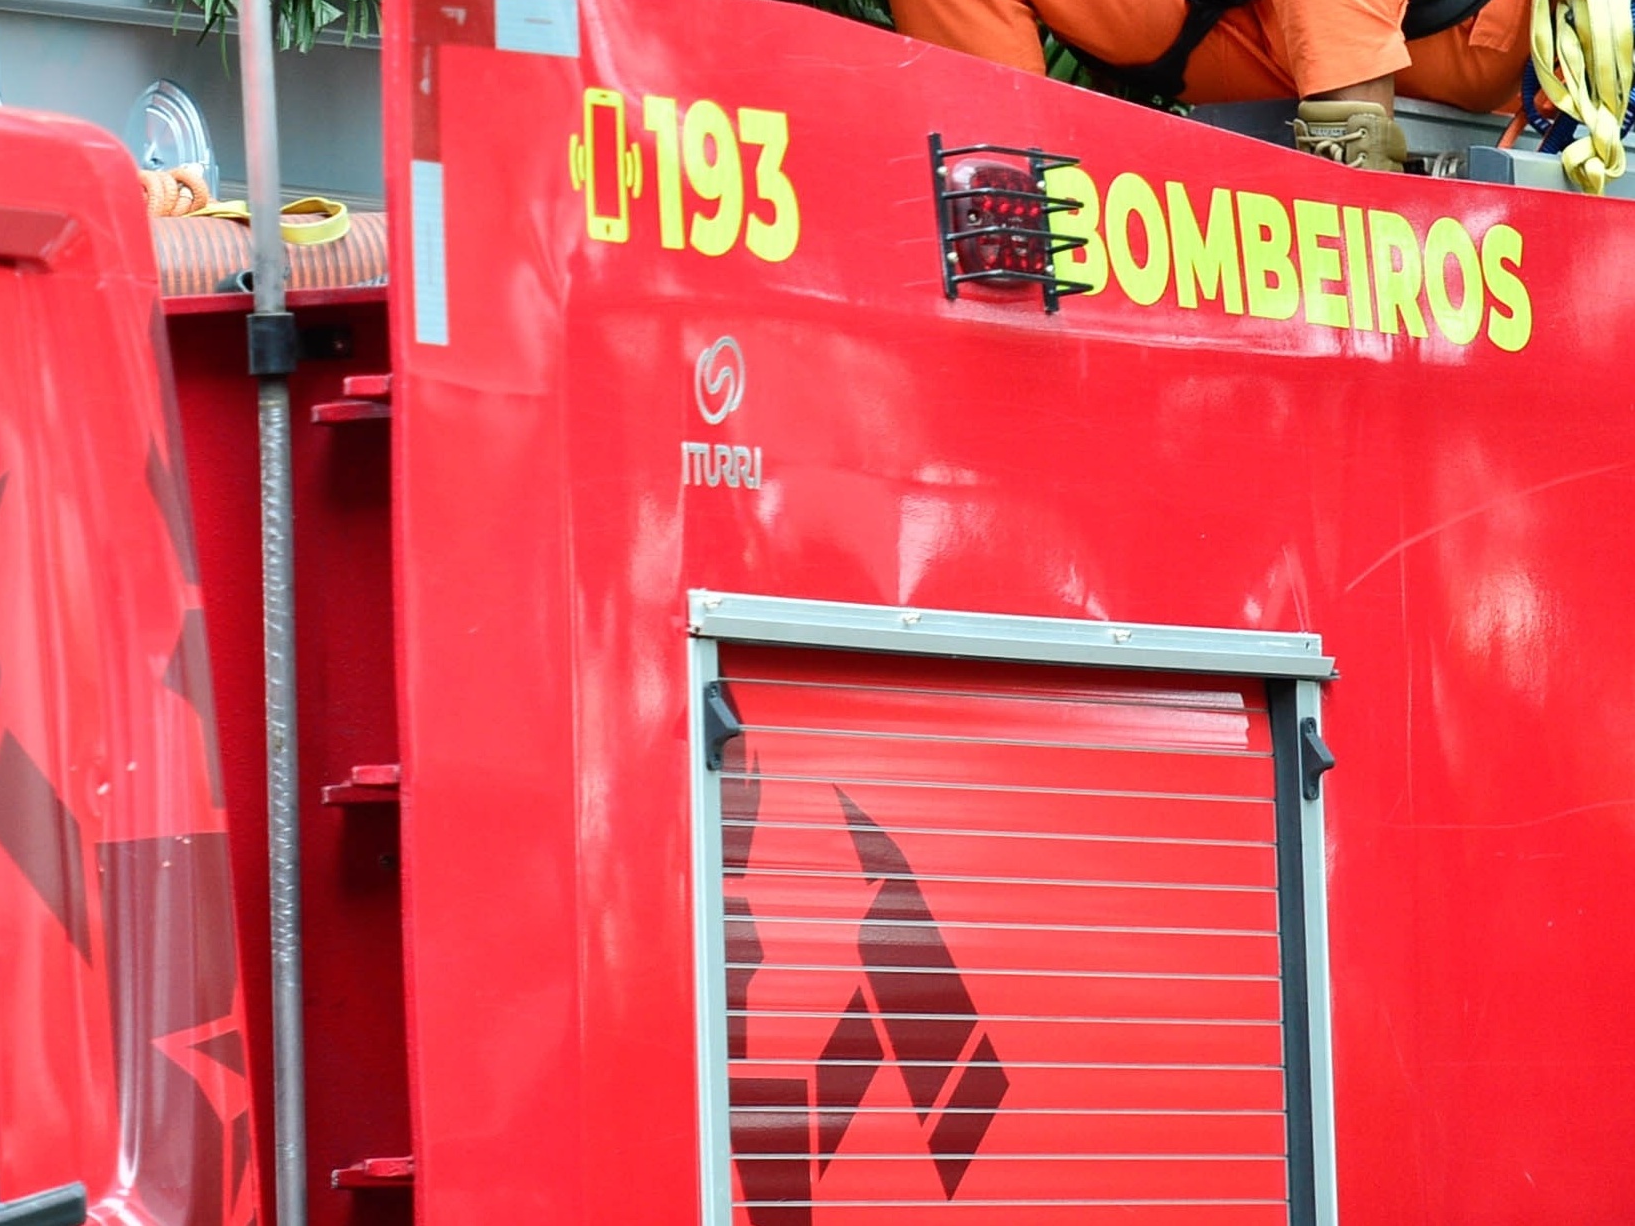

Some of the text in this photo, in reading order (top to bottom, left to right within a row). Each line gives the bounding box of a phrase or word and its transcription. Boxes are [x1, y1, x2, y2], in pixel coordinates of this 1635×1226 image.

[643, 95, 800, 262] 193
[1043, 164, 1533, 352] BOMBEIROS
[681, 441, 762, 490] ITURRI
